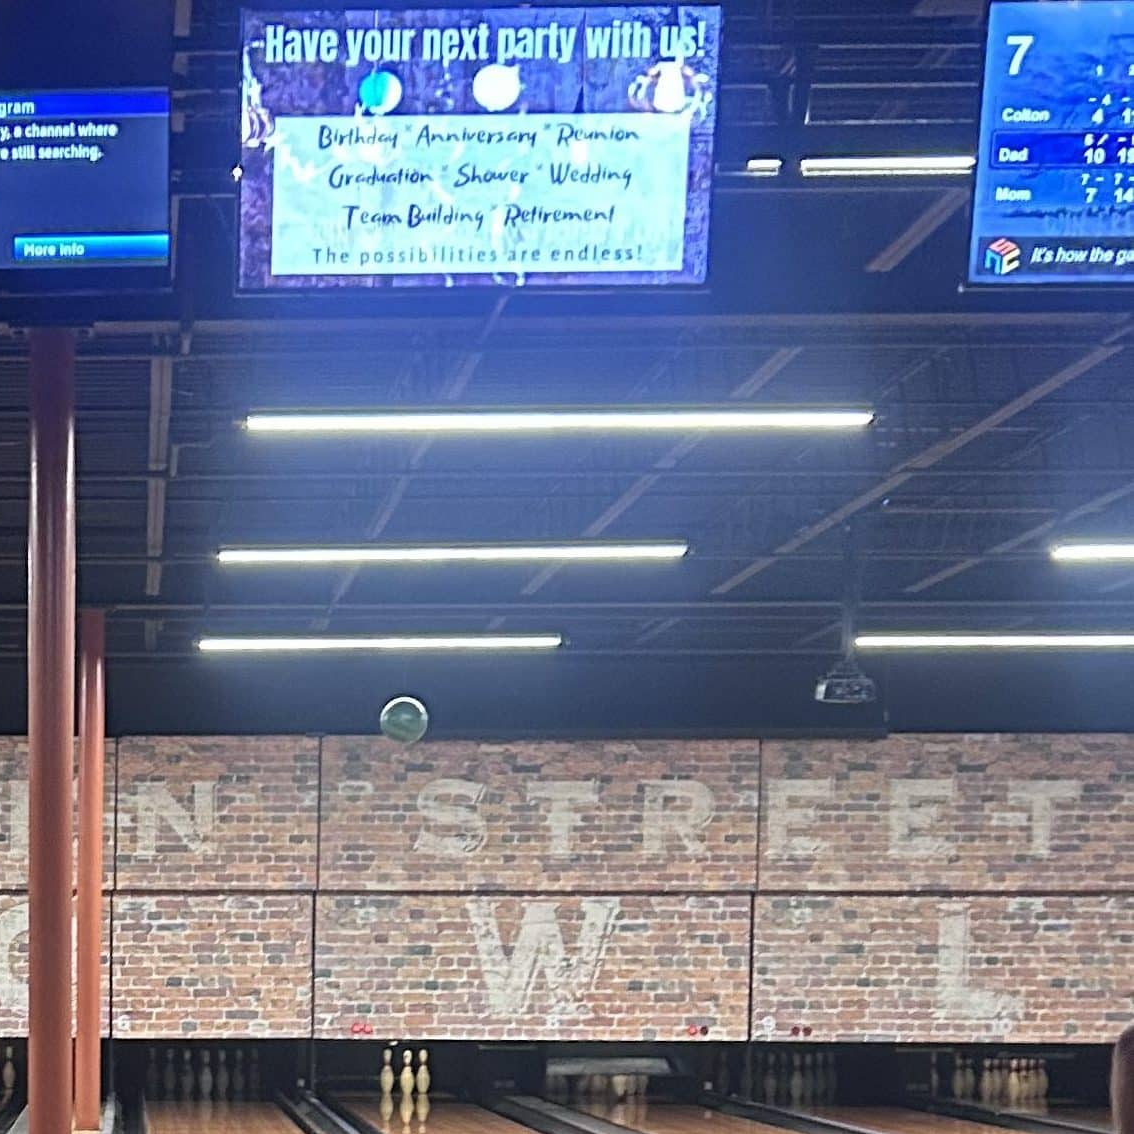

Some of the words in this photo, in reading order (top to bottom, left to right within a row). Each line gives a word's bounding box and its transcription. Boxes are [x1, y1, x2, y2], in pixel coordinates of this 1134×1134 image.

[266, 24, 338, 63] Have
[345, 23, 414, 67] your
[422, 22, 489, 62] next
[497, 23, 577, 64] party
[584, 20, 651, 59] with
[659, 21, 706, 59] us!
[1006, 35, 1034, 76] 7
[25, 121, 76, 138] channel
[78, 121, 118, 137] where
[318, 124, 399, 150] Birthday
[416, 123, 537, 149] Anniversary
[557, 124, 640, 146] Reunion
[11, 144, 36, 160] still
[38, 144, 104, 162] searching.
[998, 147, 1029, 163] Dad
[1084, 147, 1106, 165] 10
[328, 167, 434, 190] Graduation
[453, 163, 531, 189] Shower
[550, 163, 632, 191] Wedding
[995, 187, 1031, 202] Mom
[342, 204, 402, 232] Team
[407, 203, 486, 232] Building
[504, 203, 615, 228] Retirement
[23, 243, 56, 257] More
[59, 242, 85, 257] Info
[314, 247, 350, 264] The
[360, 245, 498, 268] possibilities
[508, 247, 541, 262] are
[550, 242, 644, 263] endless!
[1055, 246, 1088, 264] how
[1089, 246, 1115, 264] the
[414, 778, 1082, 857] STREET
